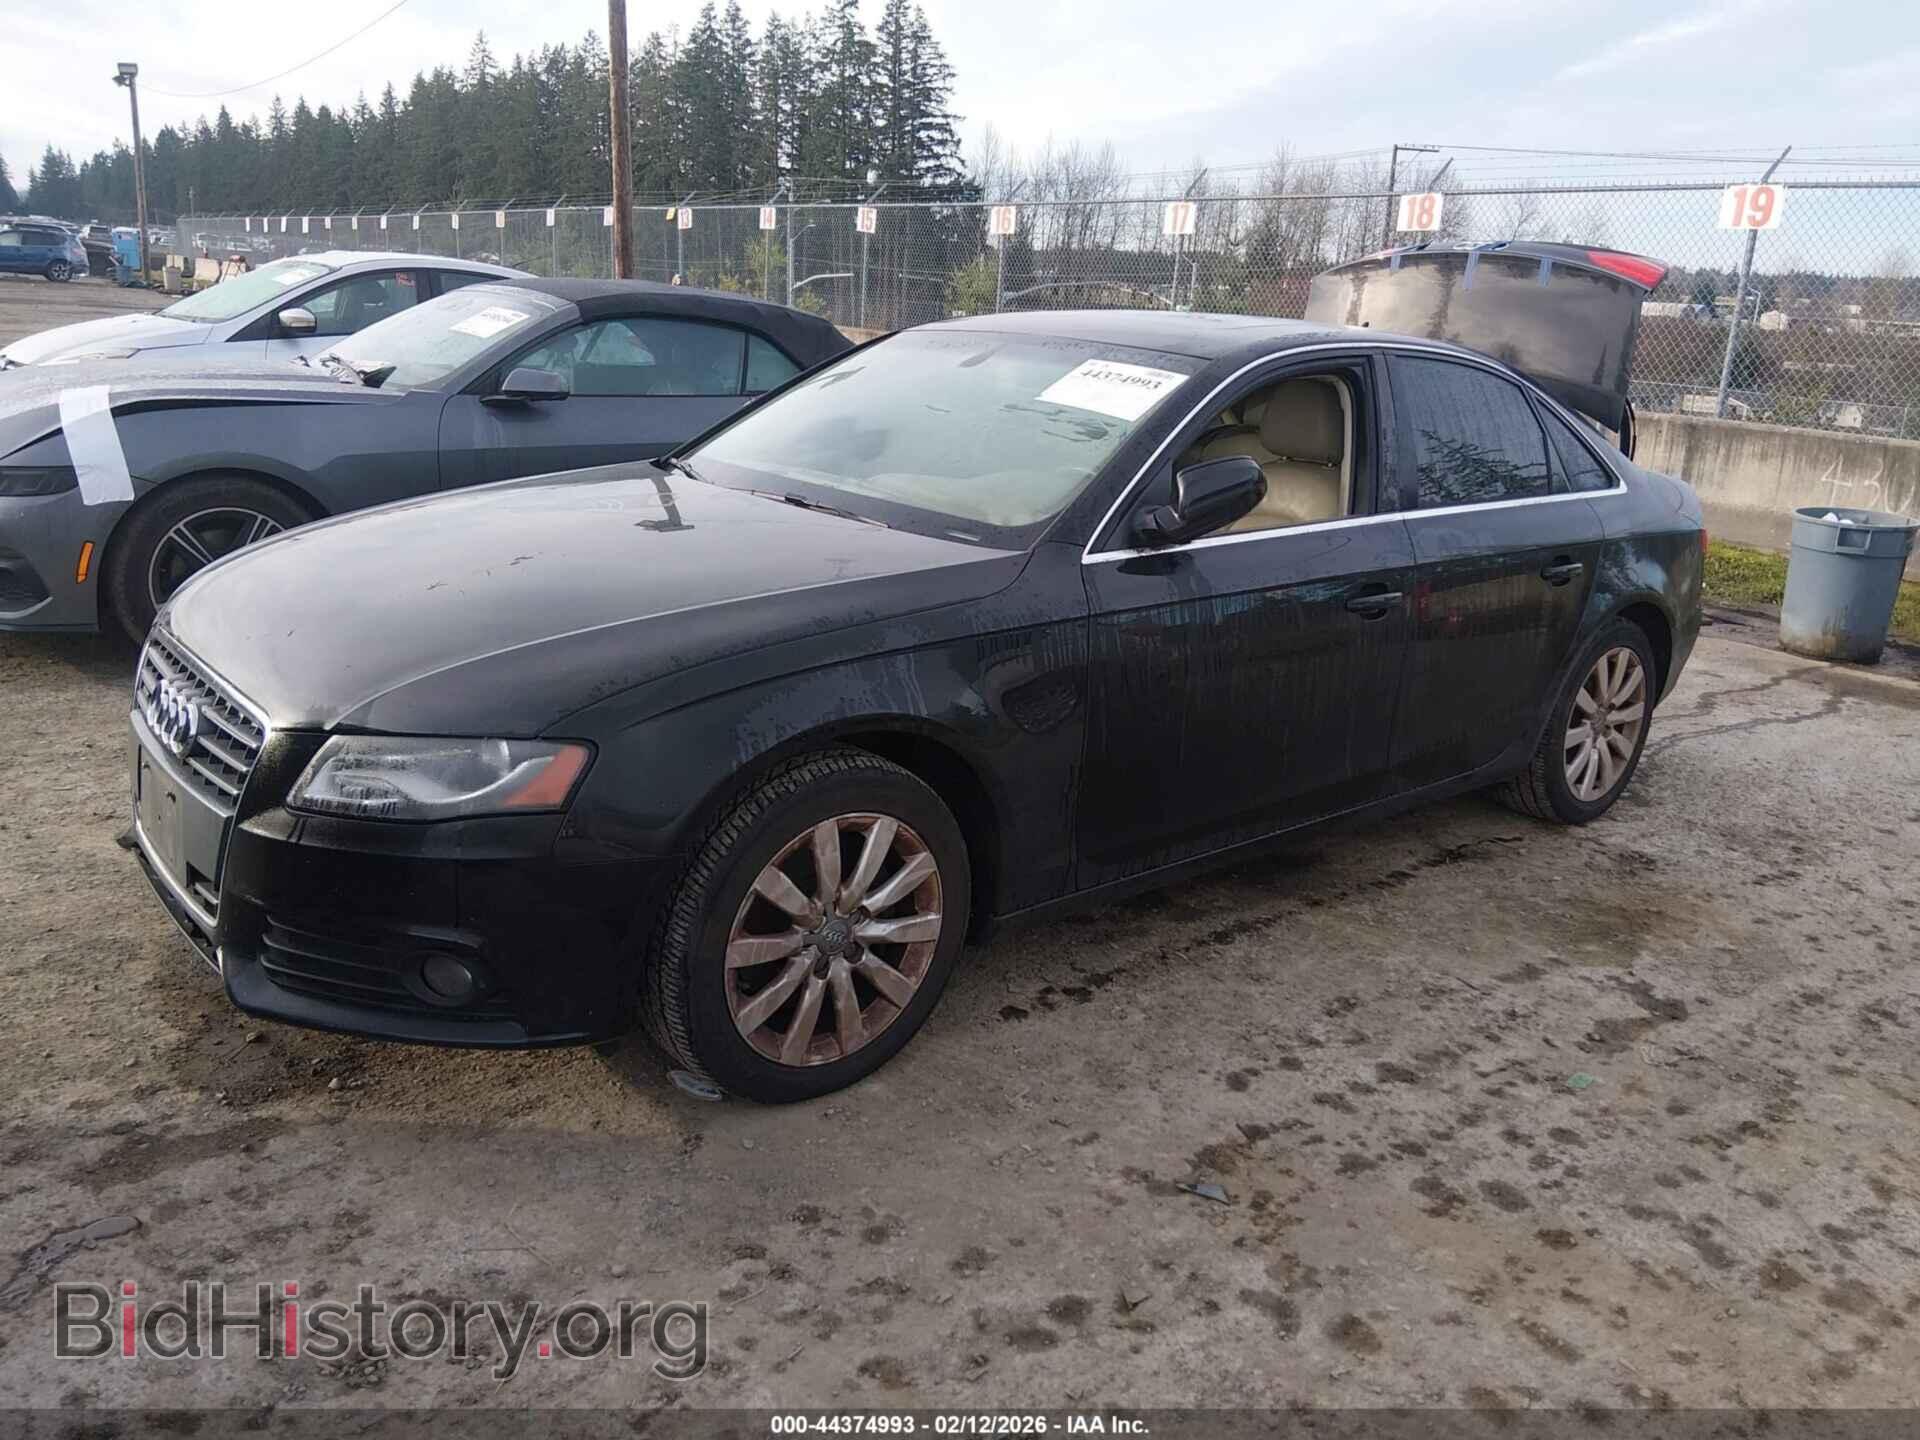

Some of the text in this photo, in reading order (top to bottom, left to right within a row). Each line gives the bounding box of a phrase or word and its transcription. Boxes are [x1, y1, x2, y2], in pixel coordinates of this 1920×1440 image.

[861, 208, 874, 230] 15
[995, 207, 1011, 232] 16
[1172, 204, 1191, 232] 17
[1407, 193, 1436, 229] 18
[1731, 186, 1775, 227] 19
